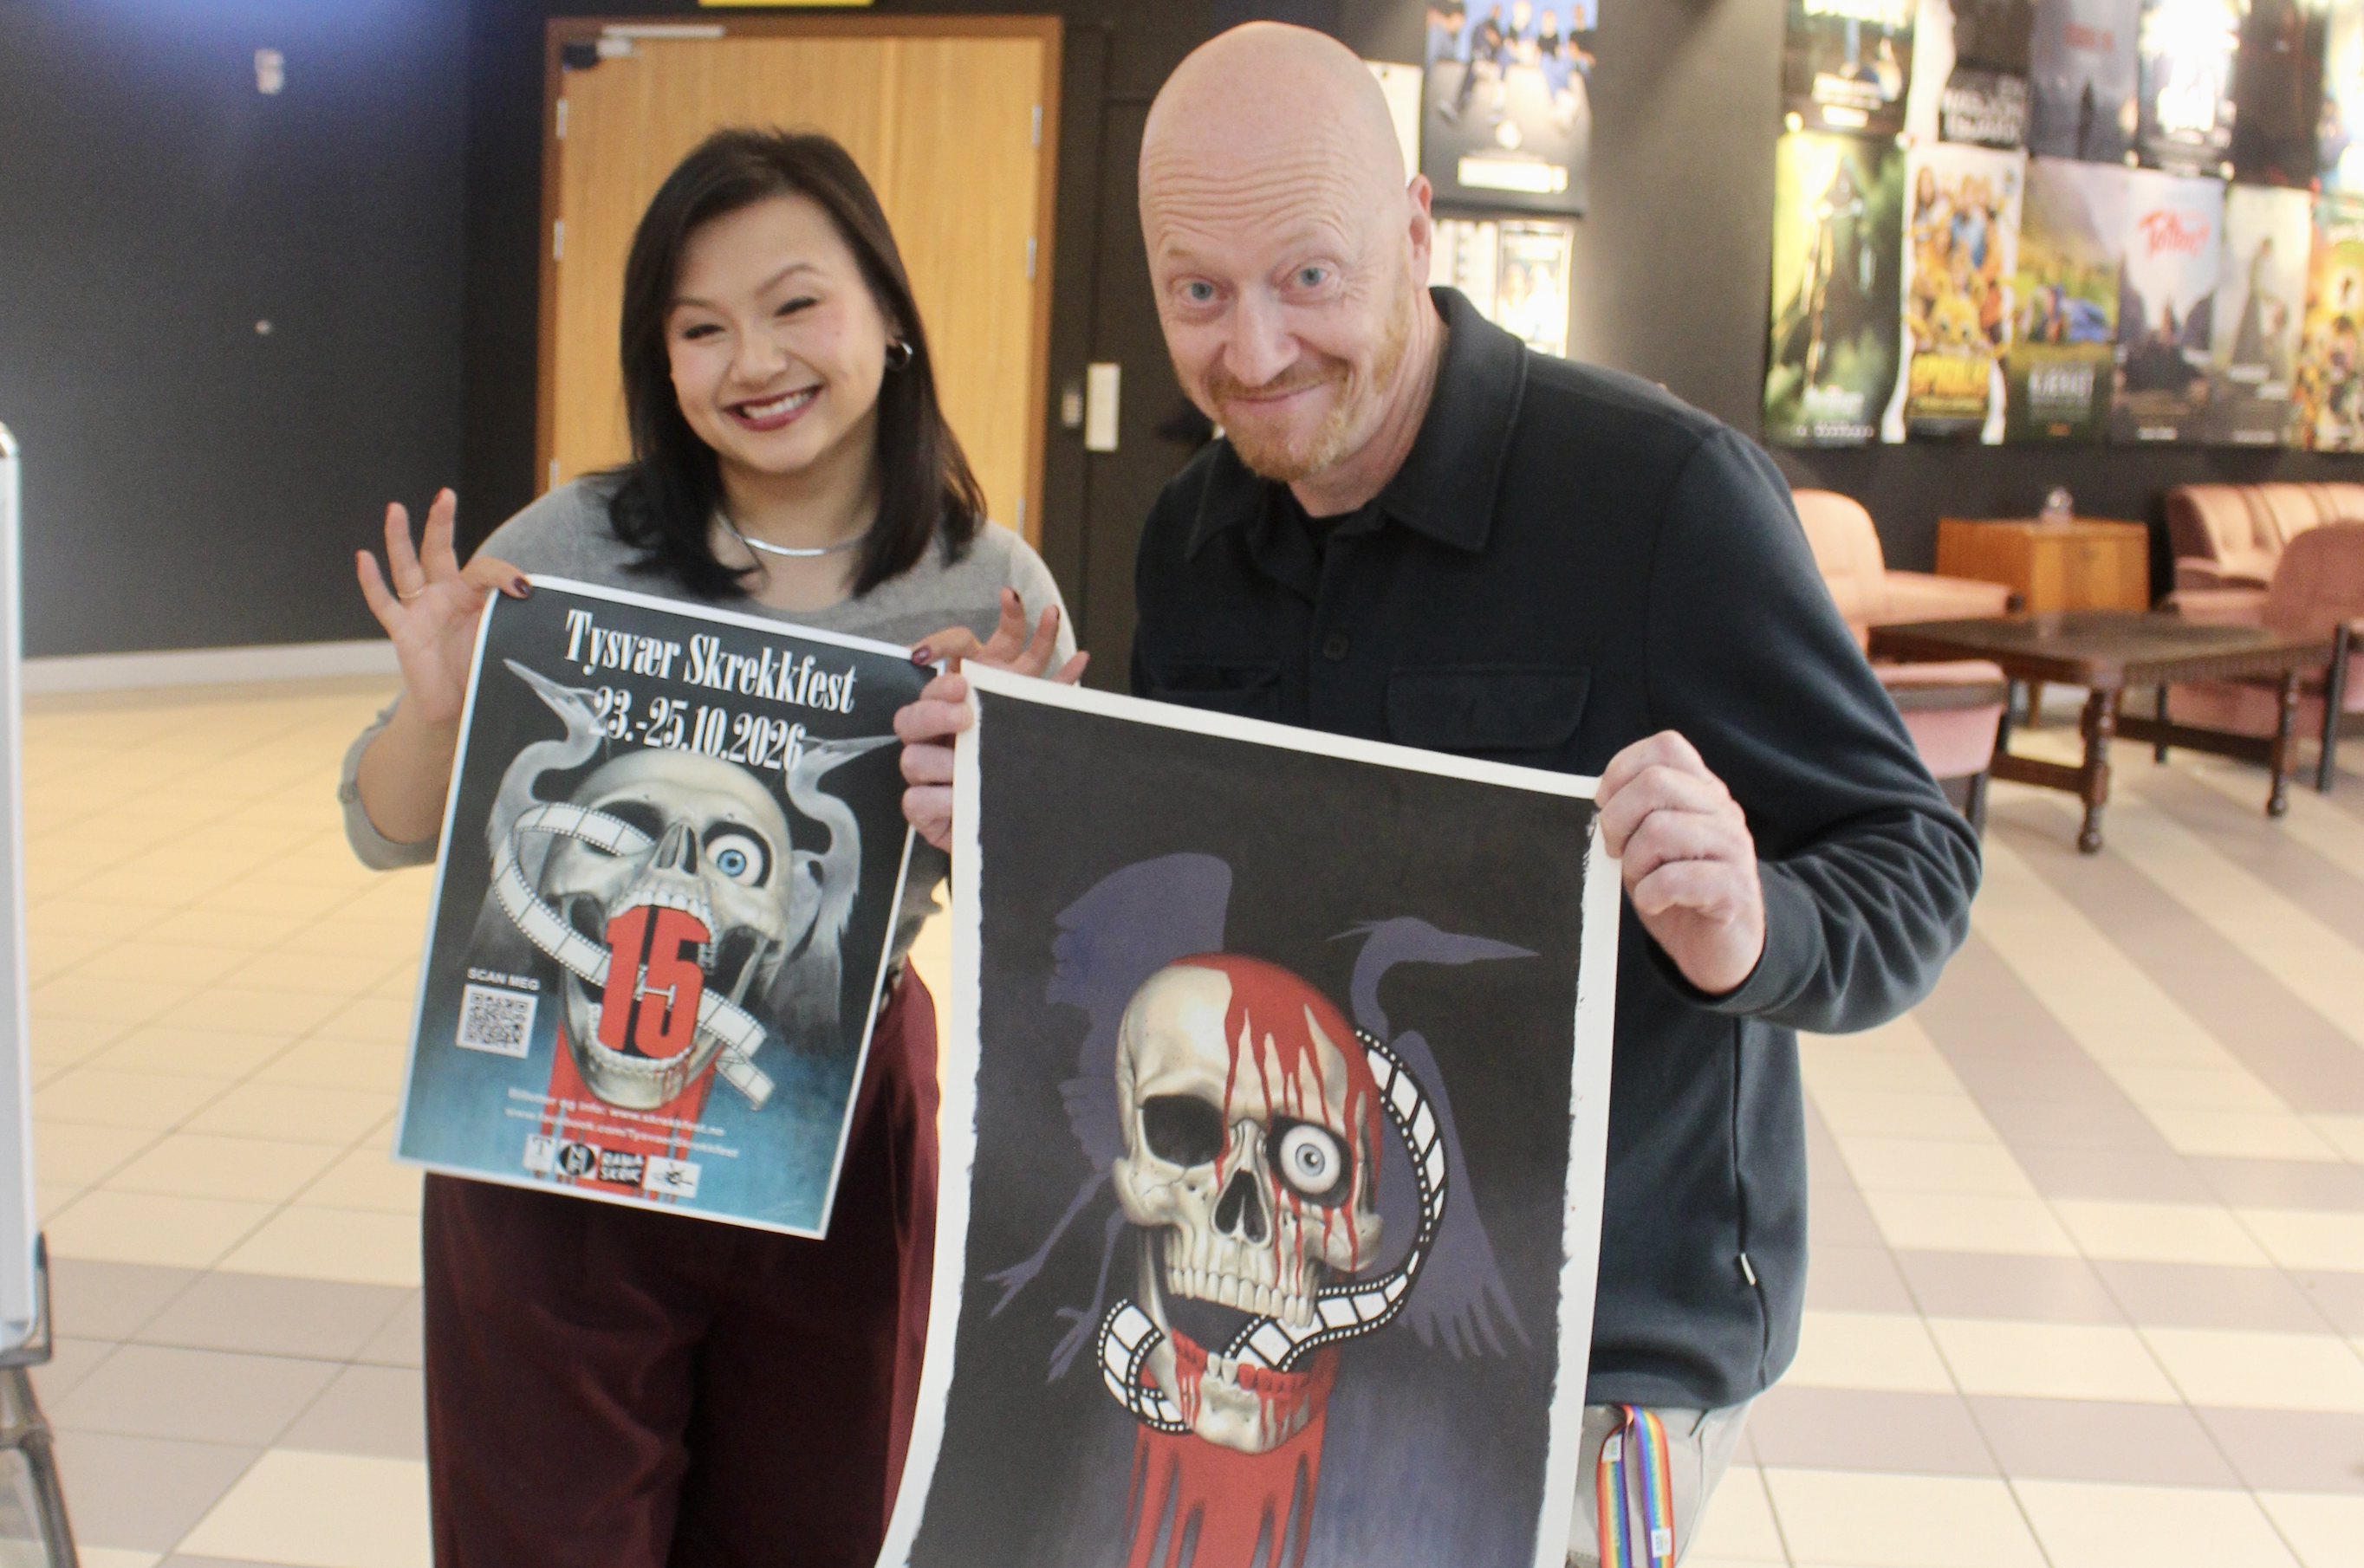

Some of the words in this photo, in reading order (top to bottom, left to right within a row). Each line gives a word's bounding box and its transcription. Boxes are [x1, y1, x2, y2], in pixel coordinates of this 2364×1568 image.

[564, 609, 681, 678] Tysvær
[684, 633, 859, 714] Skrekkfest
[594, 685, 807, 772] 23.-25.10.2026
[467, 967, 507, 984] SCAN
[507, 974, 541, 991] MEG
[597, 904, 711, 1059] 15
